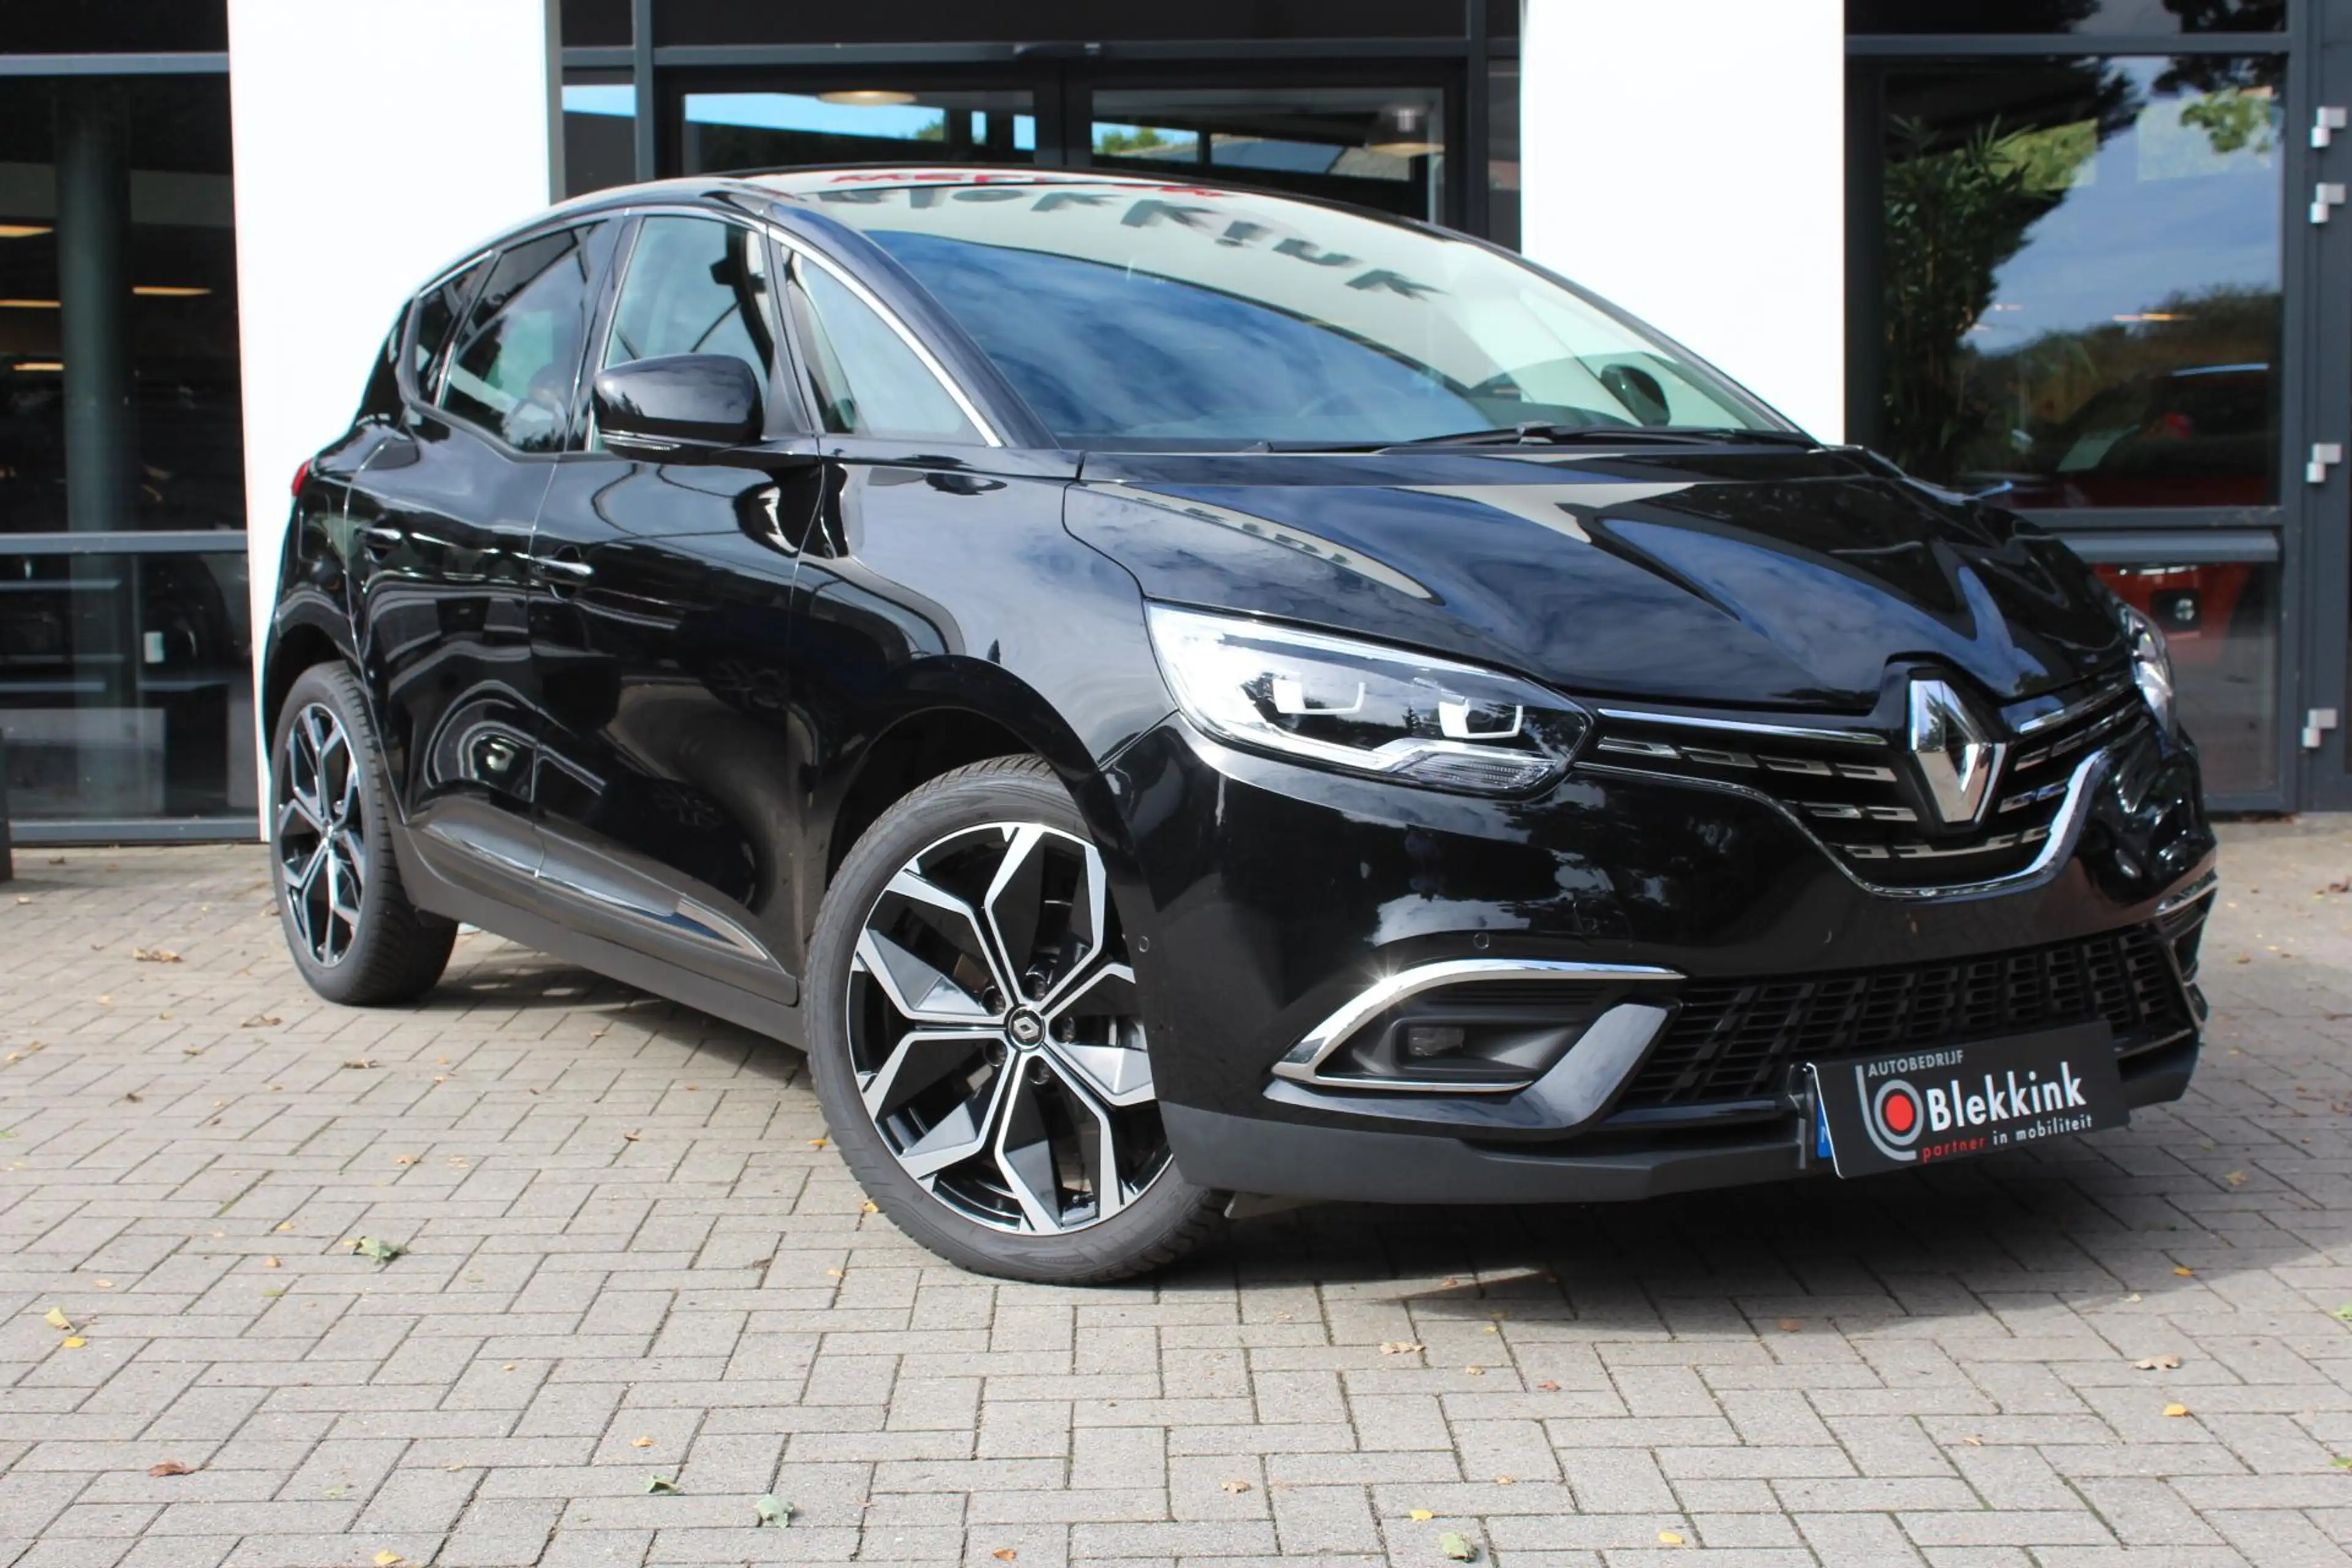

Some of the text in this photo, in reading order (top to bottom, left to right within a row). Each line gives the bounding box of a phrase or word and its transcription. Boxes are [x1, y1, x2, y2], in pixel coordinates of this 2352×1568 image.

[1868, 1050, 1964, 1077] AUTOBEDRIJF
[1926, 1061, 2087, 1132] Blekkink
[1922, 1114, 2092, 1163] partner in mobiliteit
